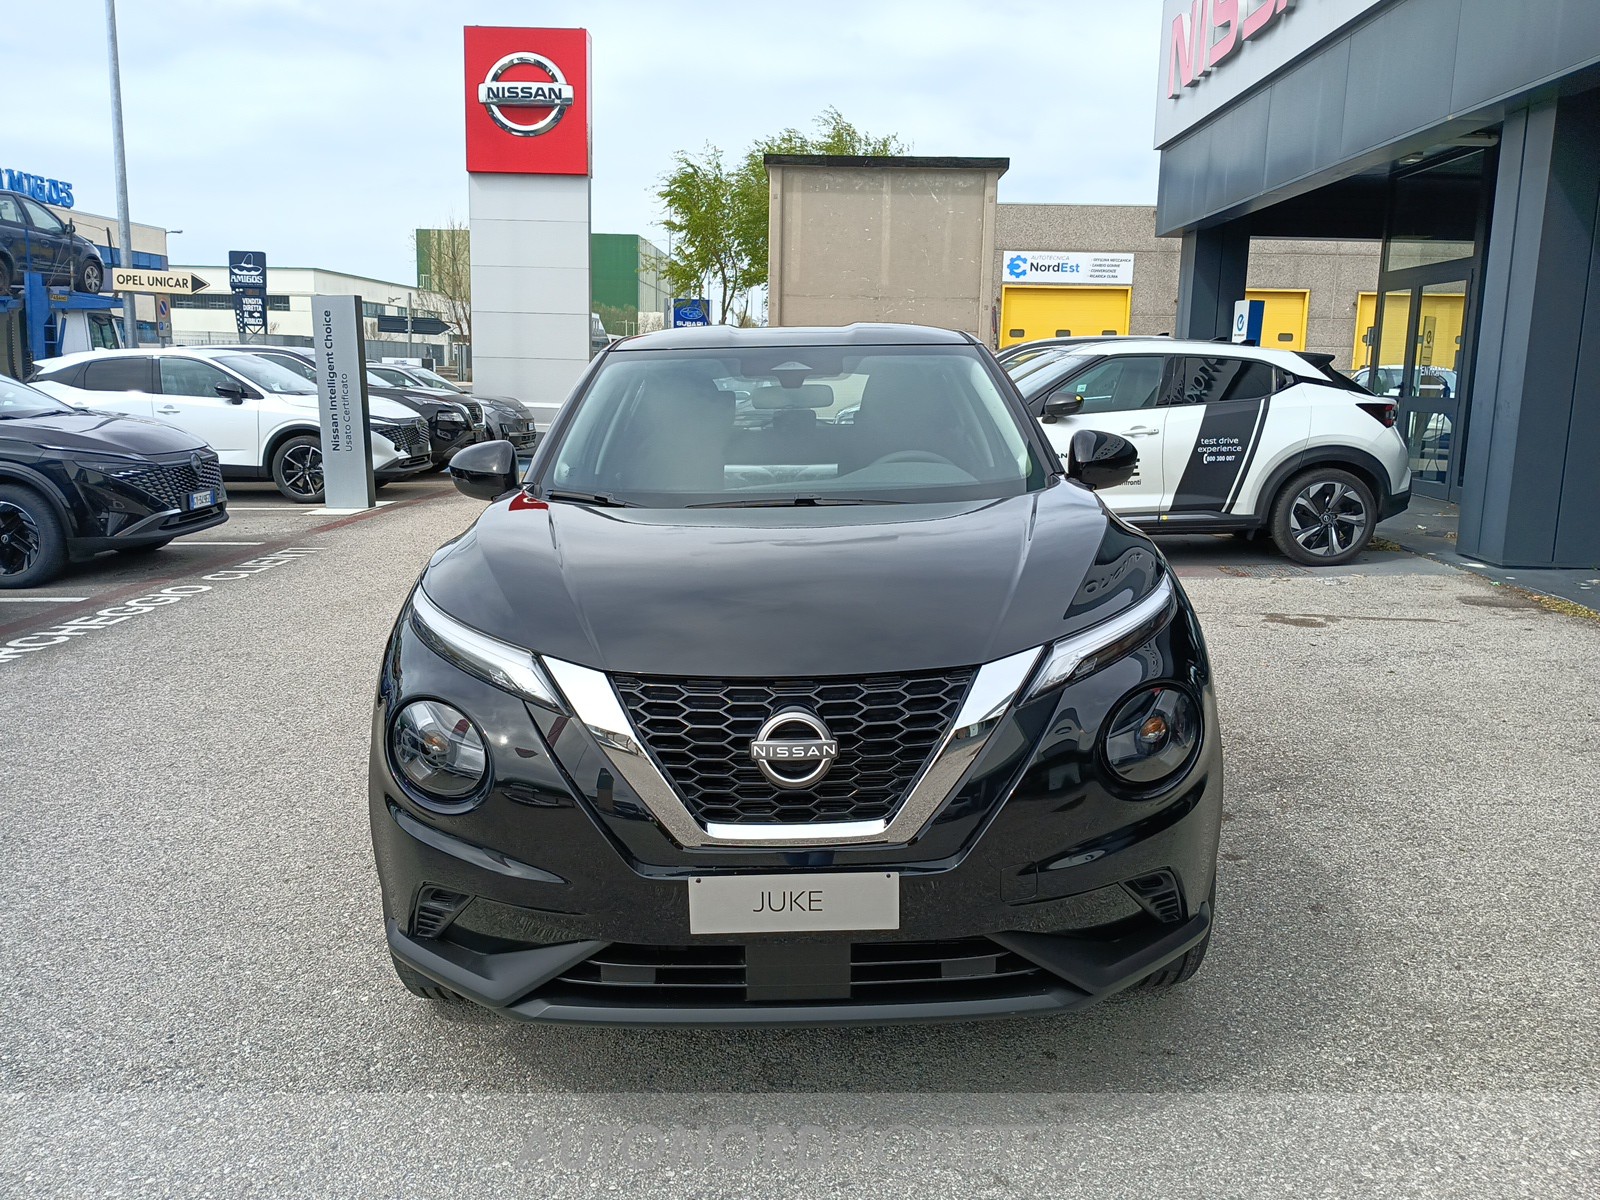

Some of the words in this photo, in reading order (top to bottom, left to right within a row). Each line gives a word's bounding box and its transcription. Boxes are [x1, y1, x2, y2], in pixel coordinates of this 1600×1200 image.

[487, 86, 563, 100] NISSAN
[0, 168, 74, 208] MIGOS
[1030, 262, 1080, 273] NordEst
[116, 274, 145, 286] OPEL
[148, 276, 189, 289] UNICAR
[231, 275, 262, 284] AMIGOS
[323, 310, 333, 349] Choice
[326, 351, 338, 411] Intelligent
[341, 373, 350, 421] Certificato
[331, 412, 341, 451] Nissan
[344, 425, 353, 452] Usato
[1197, 445, 1242, 453] experience
[753, 744, 836, 758] NISSAN
[752, 890, 824, 913] JUKE
